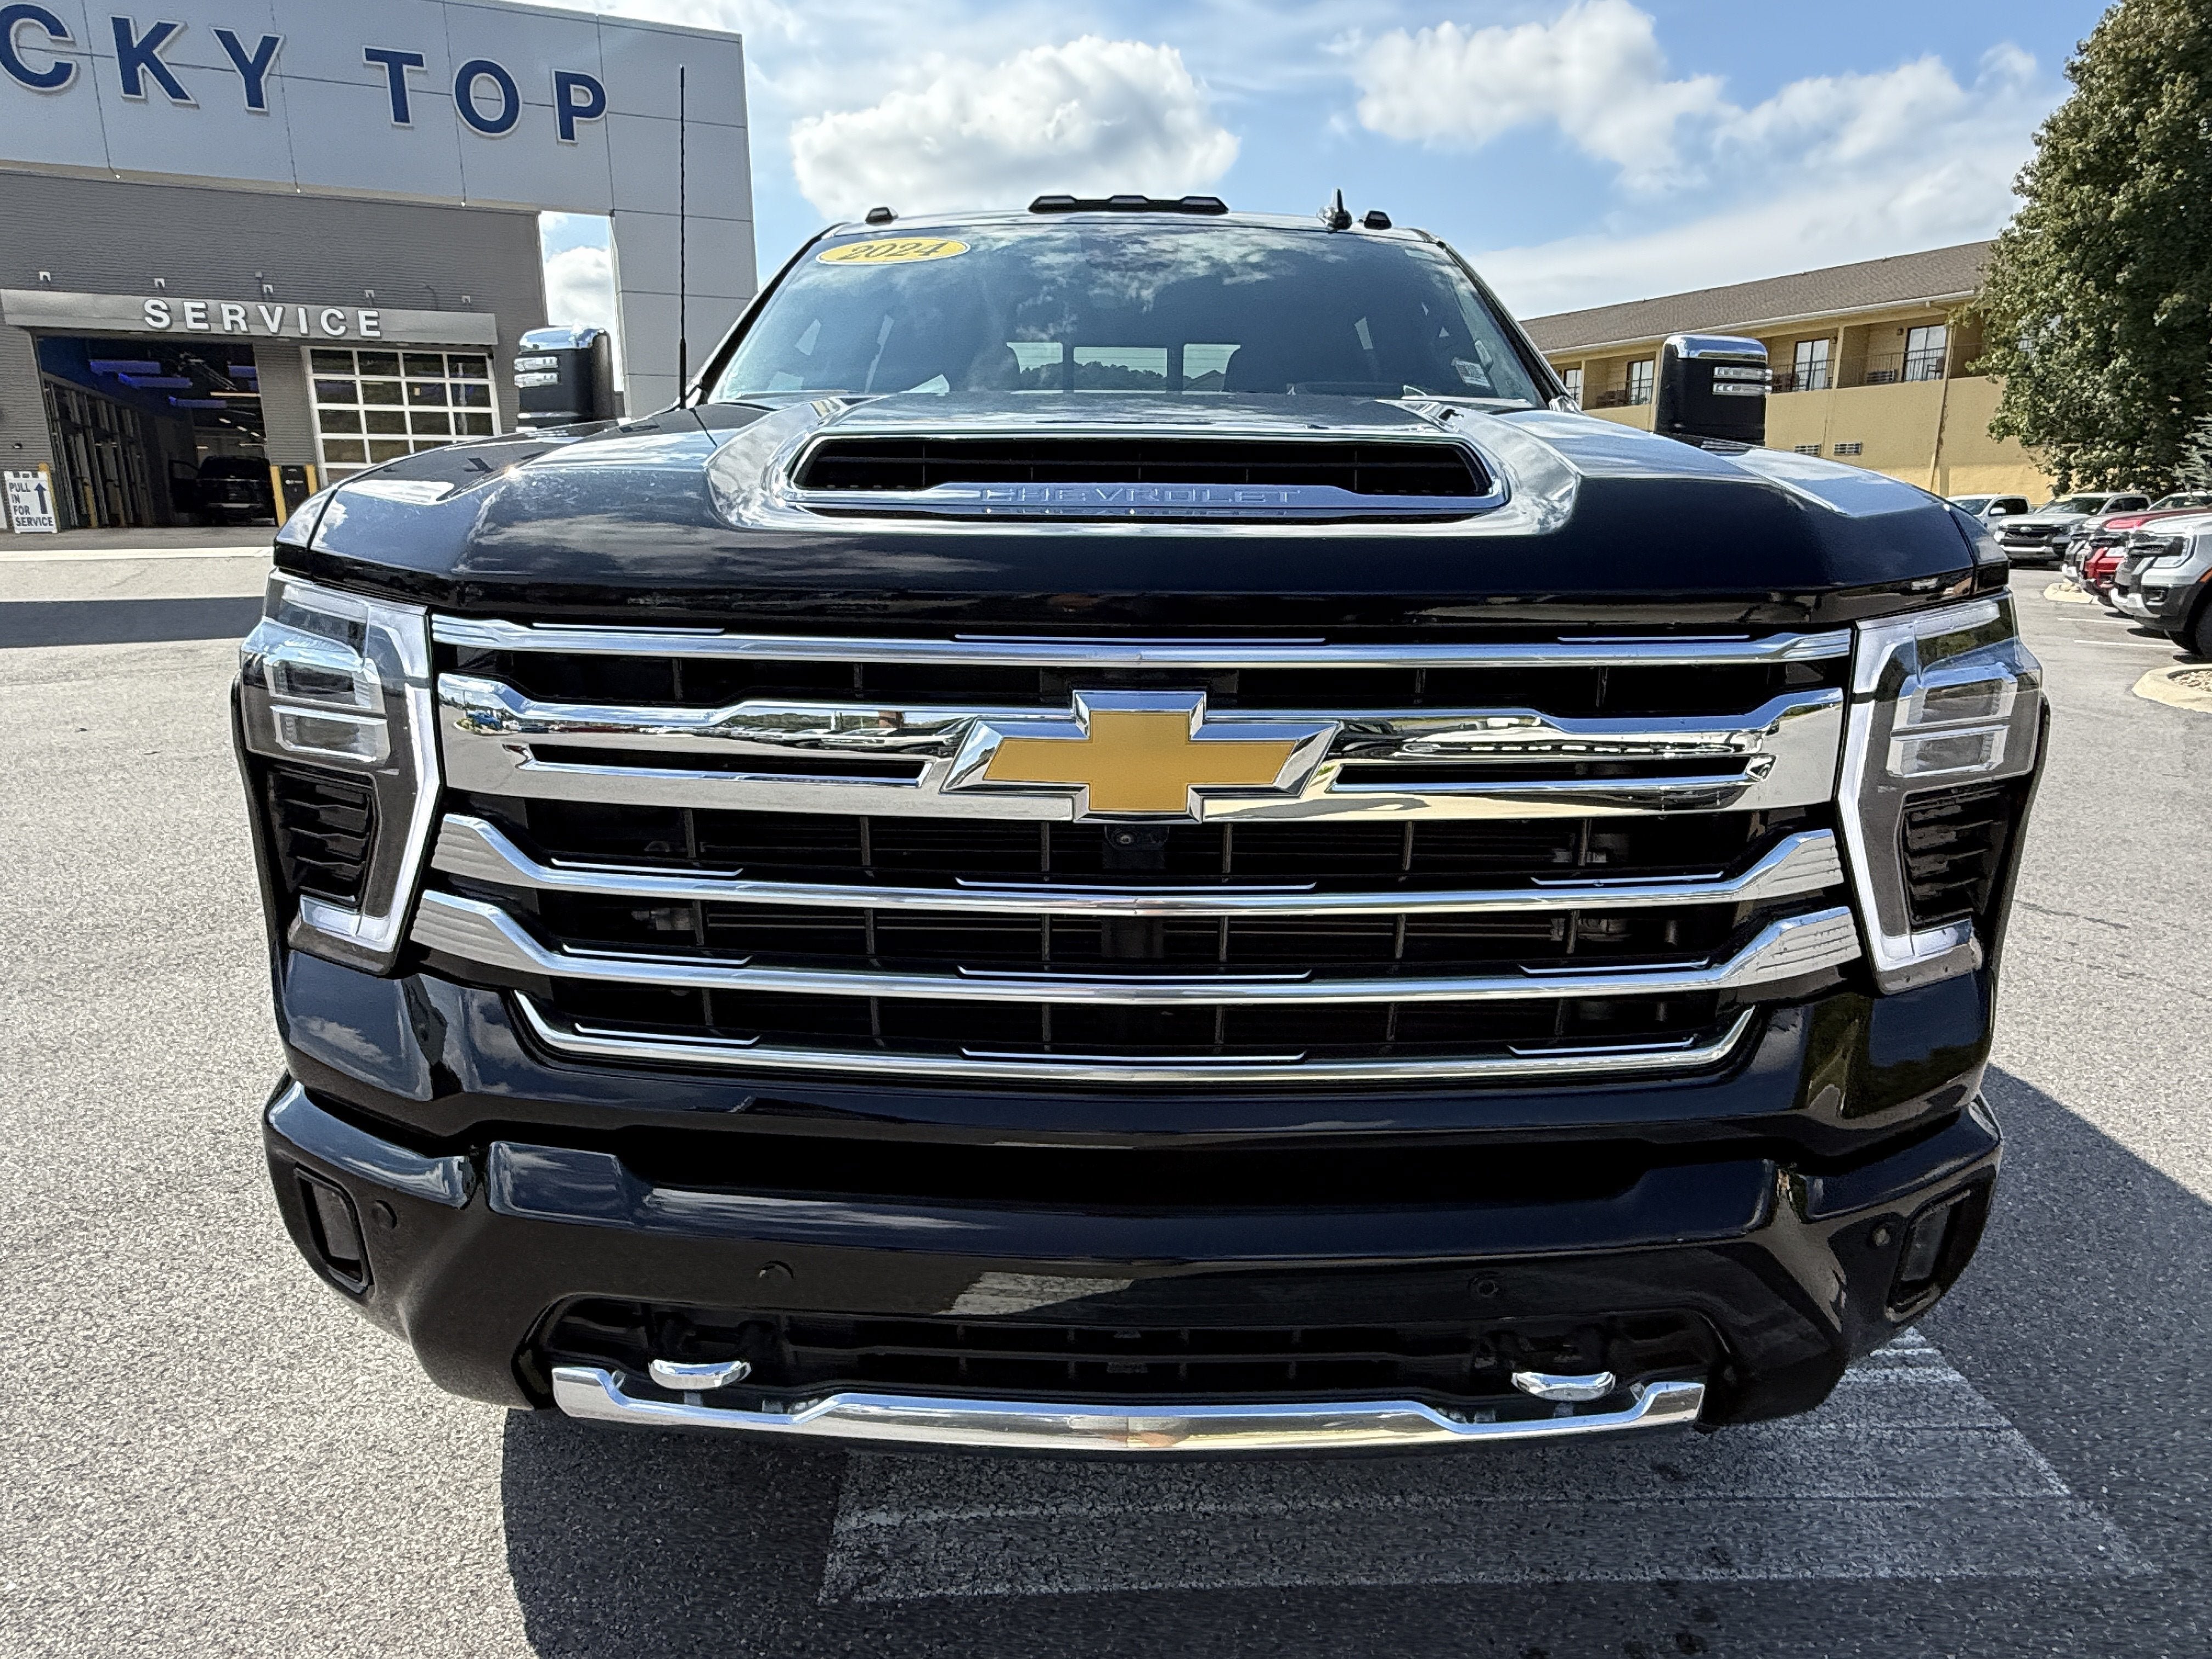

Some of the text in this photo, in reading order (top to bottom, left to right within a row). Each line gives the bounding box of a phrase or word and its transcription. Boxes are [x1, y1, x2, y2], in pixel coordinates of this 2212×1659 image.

[362, 45, 608, 144] TOP
[836, 242, 949, 260] 2024
[144, 298, 382, 338] SERVICE
[9, 482, 31, 493] PULL
[11, 494, 20, 504] IN
[981, 487, 1301, 503] CHEVROLET
[13, 505, 30, 515] FOR
[15, 517, 54, 527] SERVICE
